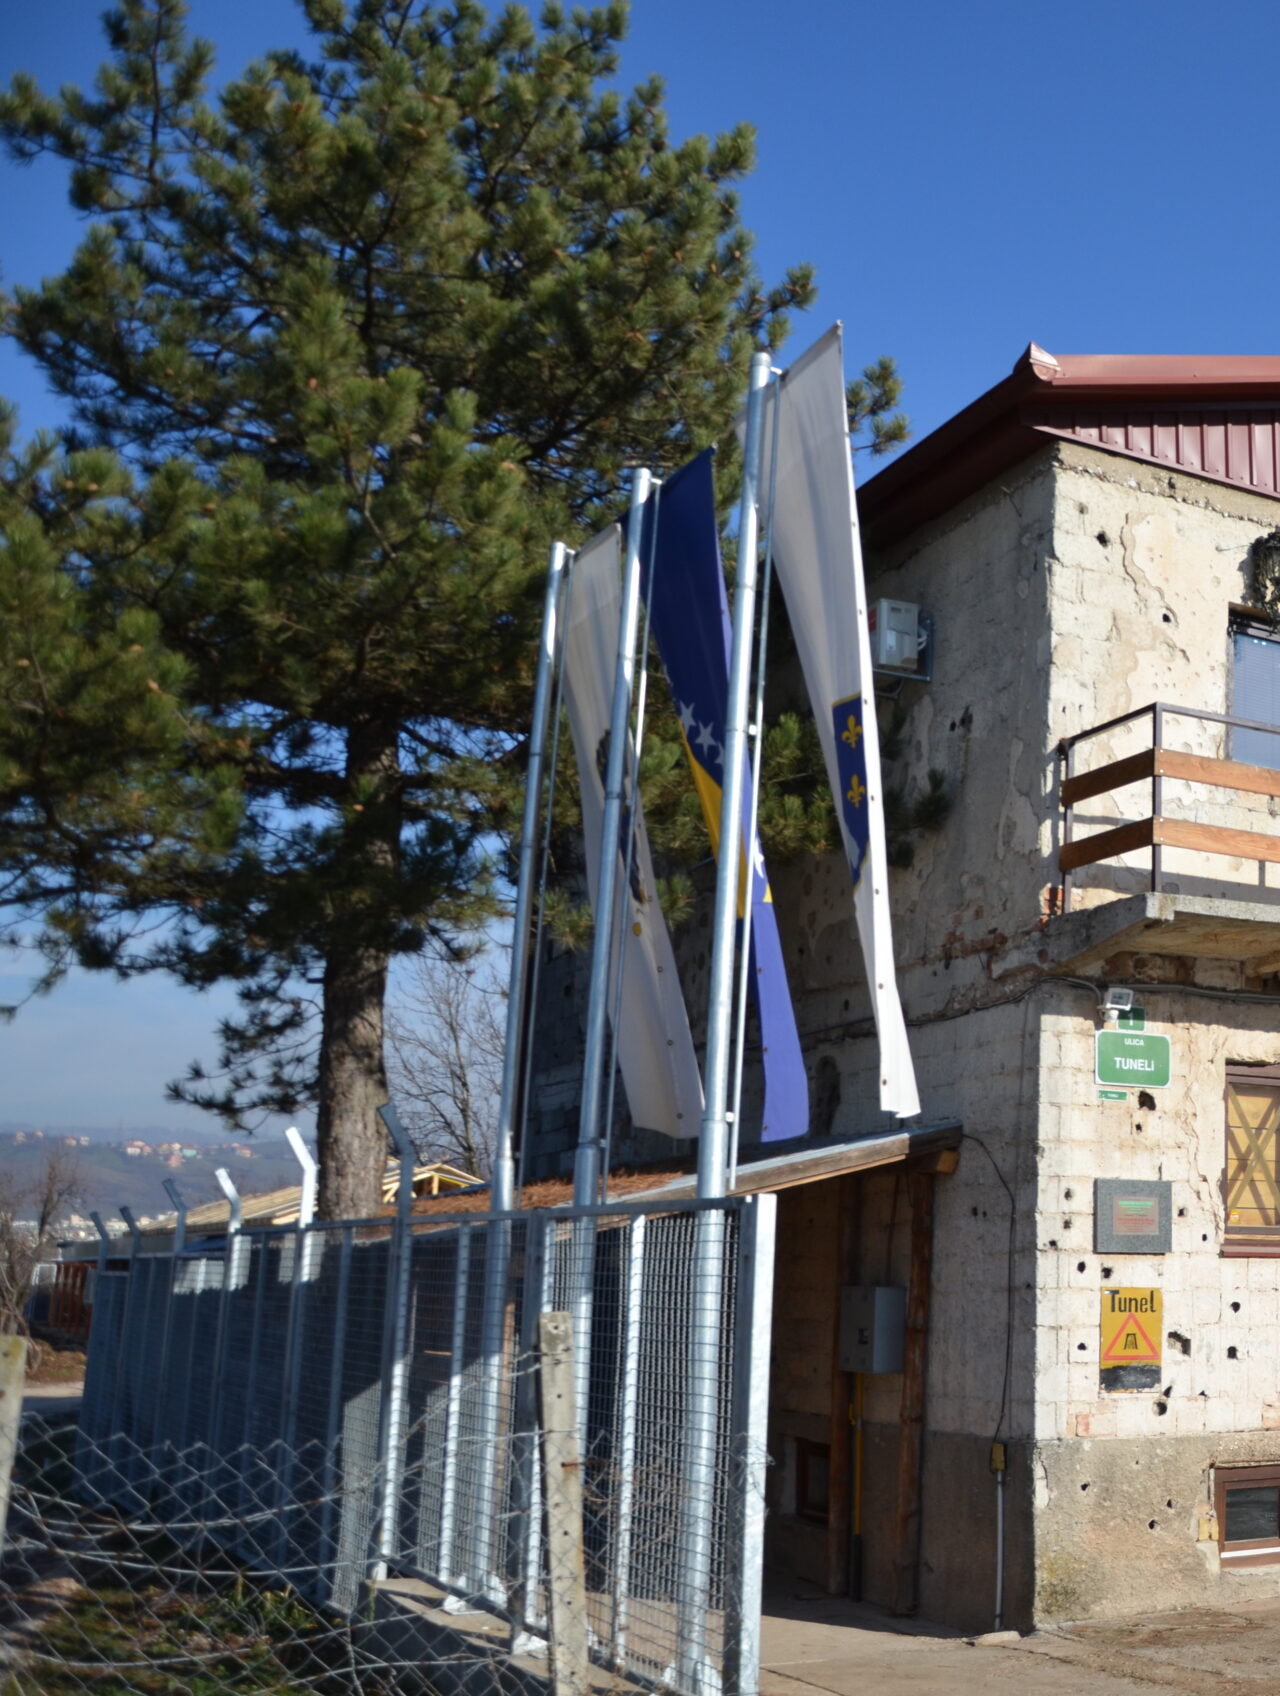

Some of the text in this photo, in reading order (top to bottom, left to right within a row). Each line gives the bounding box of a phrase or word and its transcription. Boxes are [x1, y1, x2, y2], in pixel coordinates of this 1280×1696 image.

[1127, 1011, 1135, 1026] 1
[1124, 1038, 1145, 1046] ULICA
[1104, 1290, 1156, 1313] Tunel
